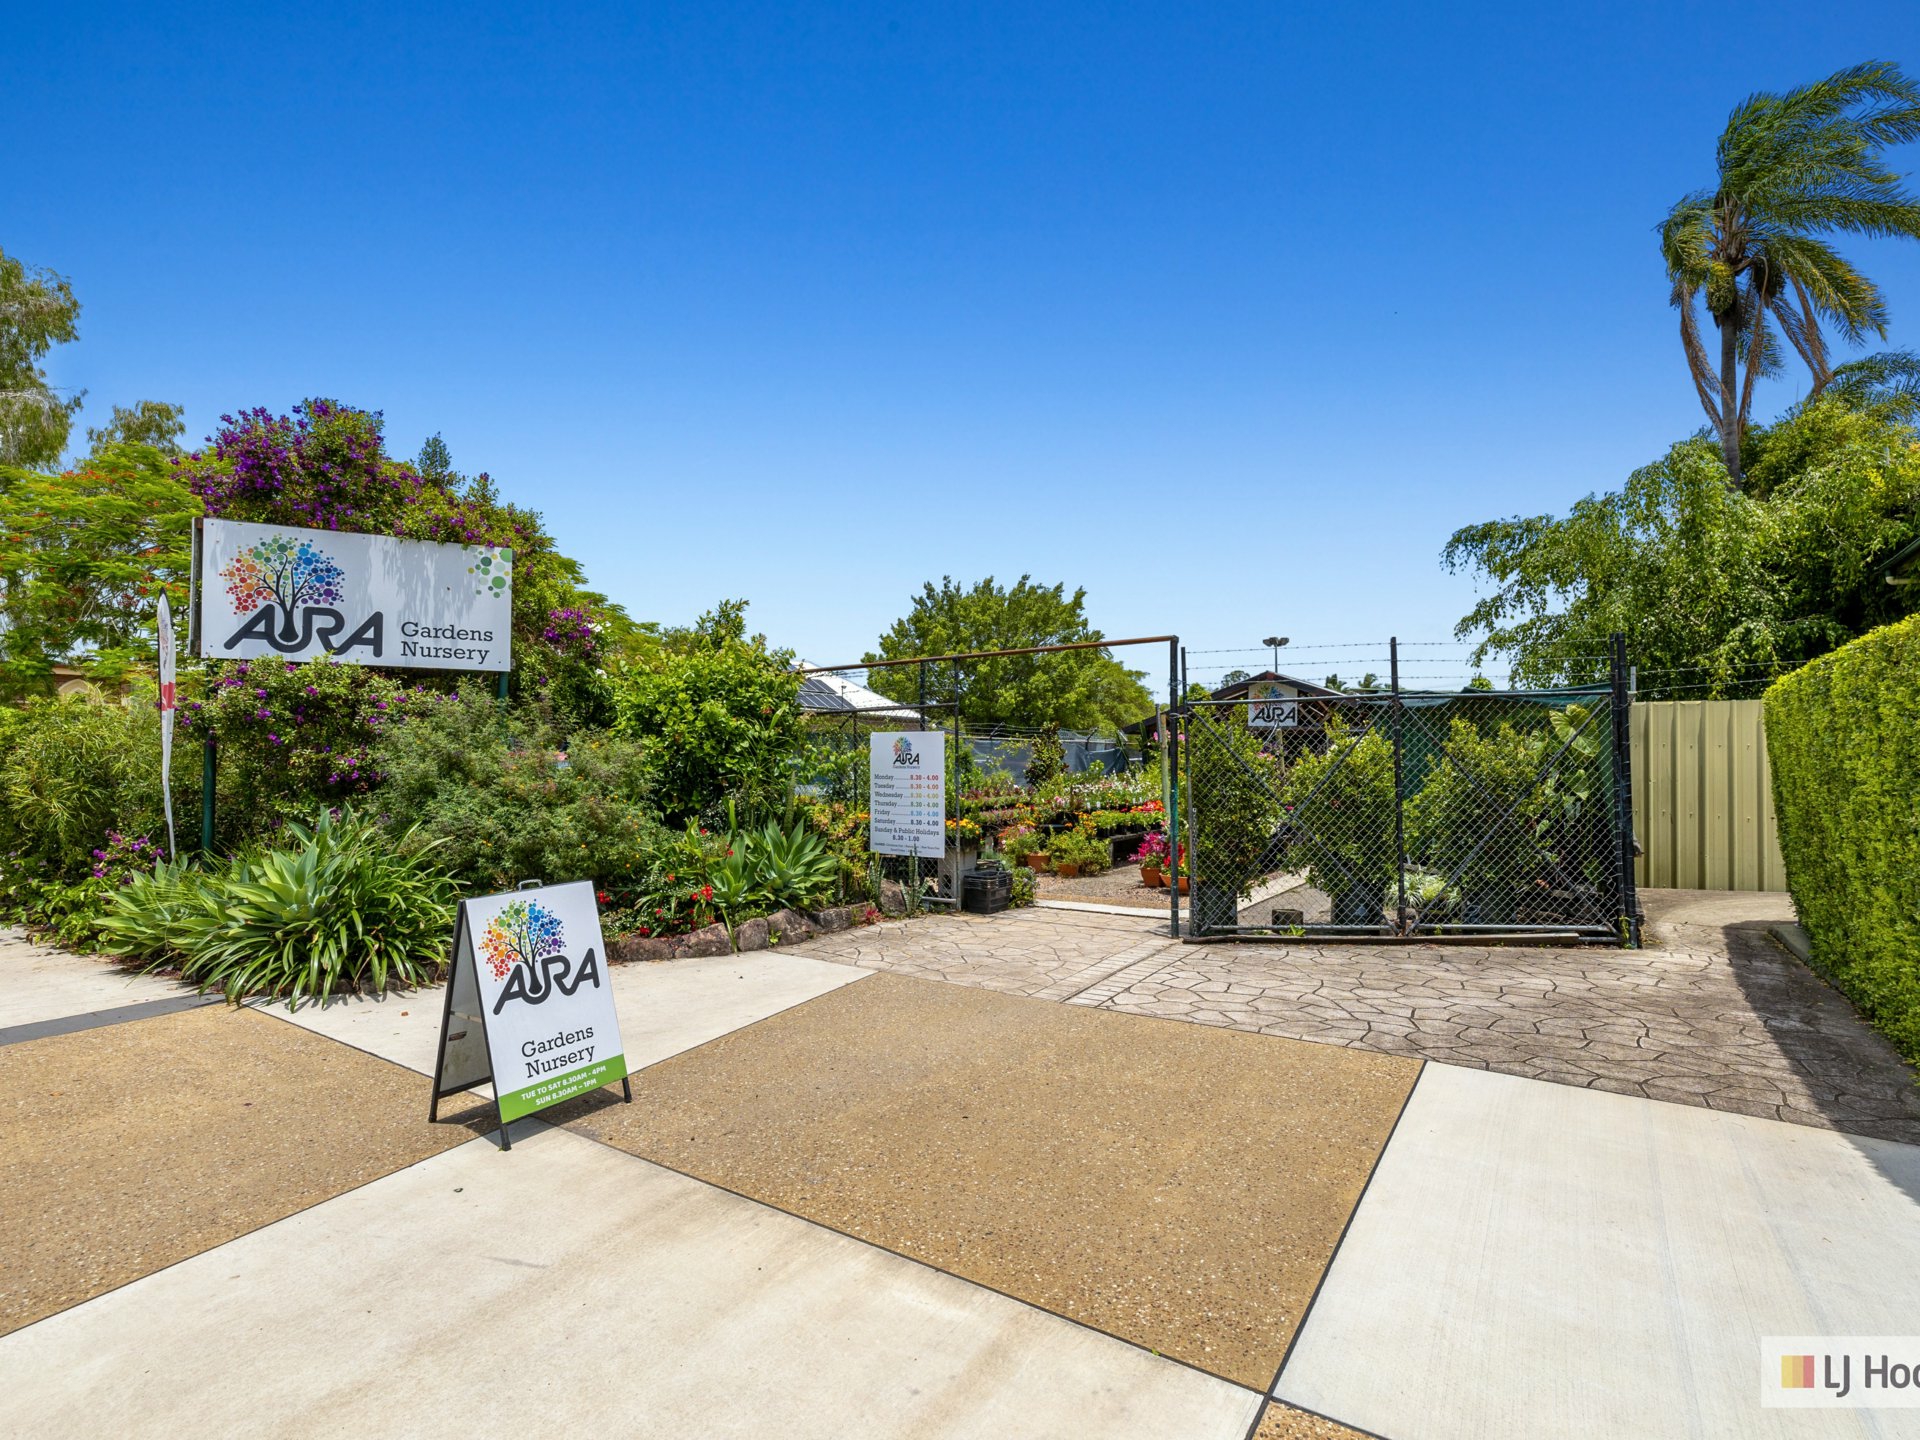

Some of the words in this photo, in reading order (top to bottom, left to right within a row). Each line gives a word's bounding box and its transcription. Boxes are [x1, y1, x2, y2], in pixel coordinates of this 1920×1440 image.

[224, 604, 384, 658] AURA
[401, 621, 494, 642] Gardens
[400, 642, 490, 664] Nursery
[1251, 706, 1296, 723] AURA
[893, 752, 919, 765] AURA
[493, 948, 600, 1015] AURA
[521, 1026, 594, 1058] Gardens
[525, 1046, 595, 1078] Nursery
[521, 1090, 536, 1100] TUE
[537, 1086, 547, 1094] TO
[548, 1081, 561, 1090] SAT
[562, 1072, 587, 1085] 8.30AM
[592, 1065, 606, 1075] 4PM
[536, 1094, 551, 1105] SUN
[552, 1085, 577, 1099] 8.30AM
[584, 1078, 597, 1087] 1PM
